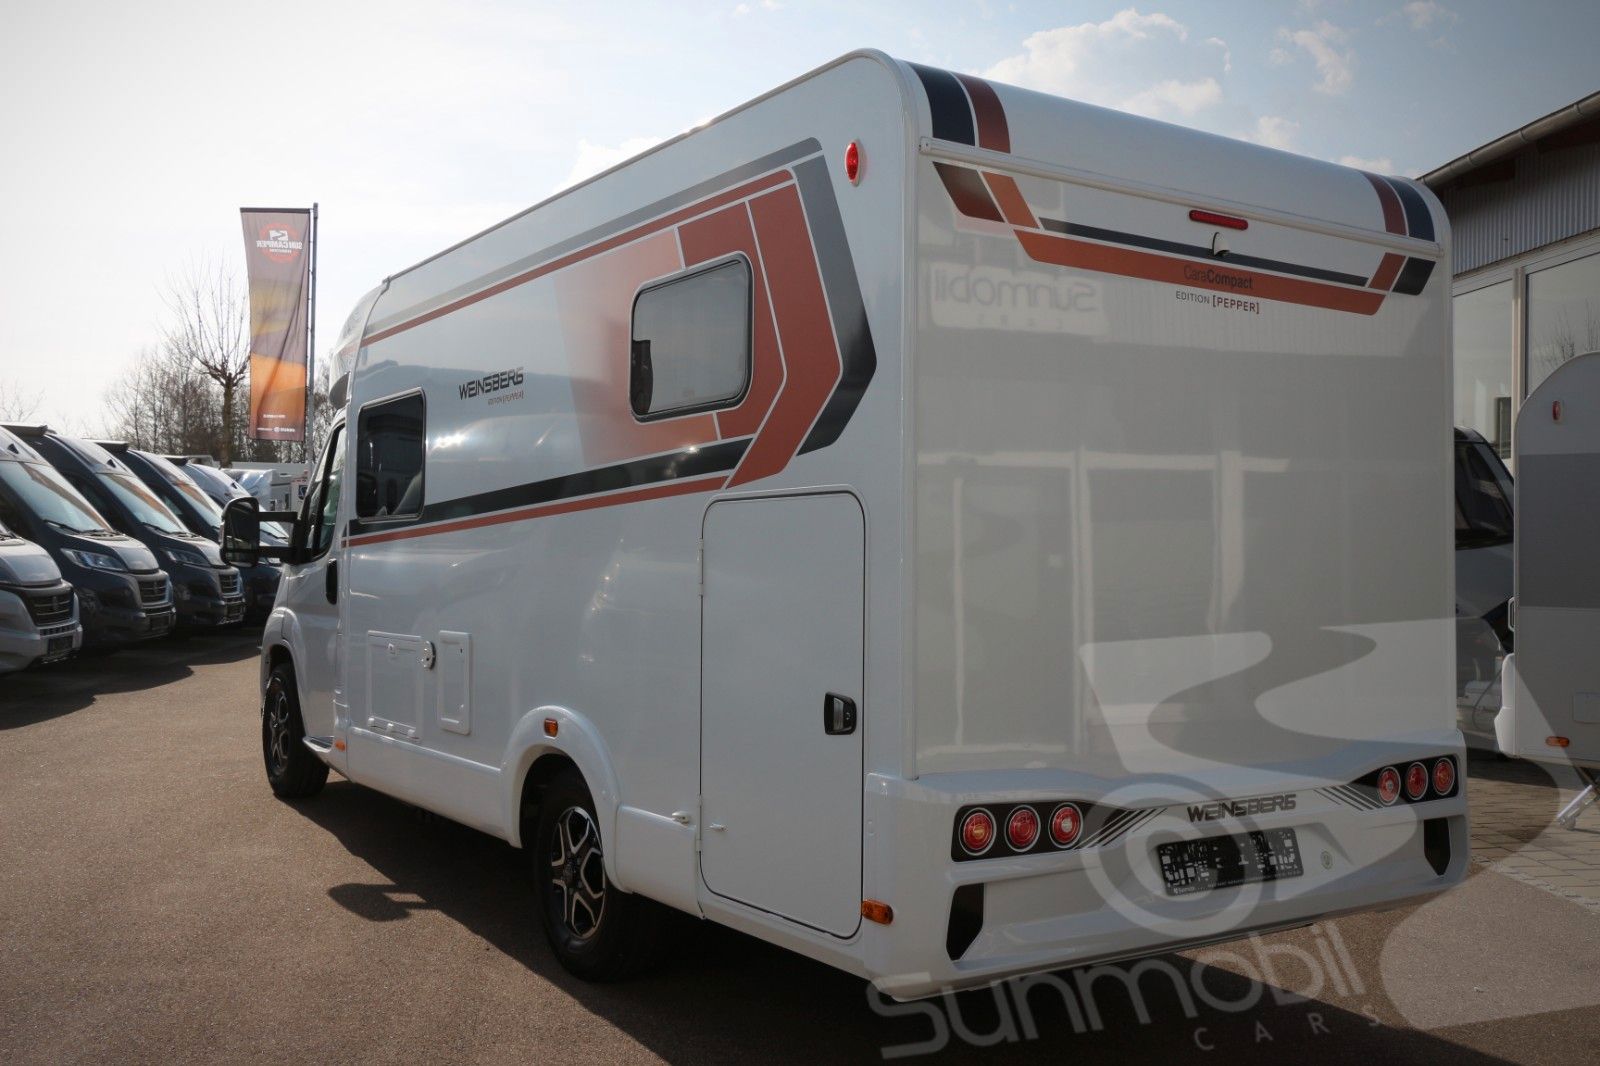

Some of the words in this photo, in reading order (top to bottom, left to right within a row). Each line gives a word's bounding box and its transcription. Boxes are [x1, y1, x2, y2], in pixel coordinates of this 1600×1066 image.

[1183, 264, 1253, 289] CaraCompact
[1175, 290, 1210, 304] EDITION
[1212, 294, 1260, 315] [PEPPER]
[459, 366, 524, 400] WEINSBERG
[1187, 793, 1297, 823] WEINSBERG
